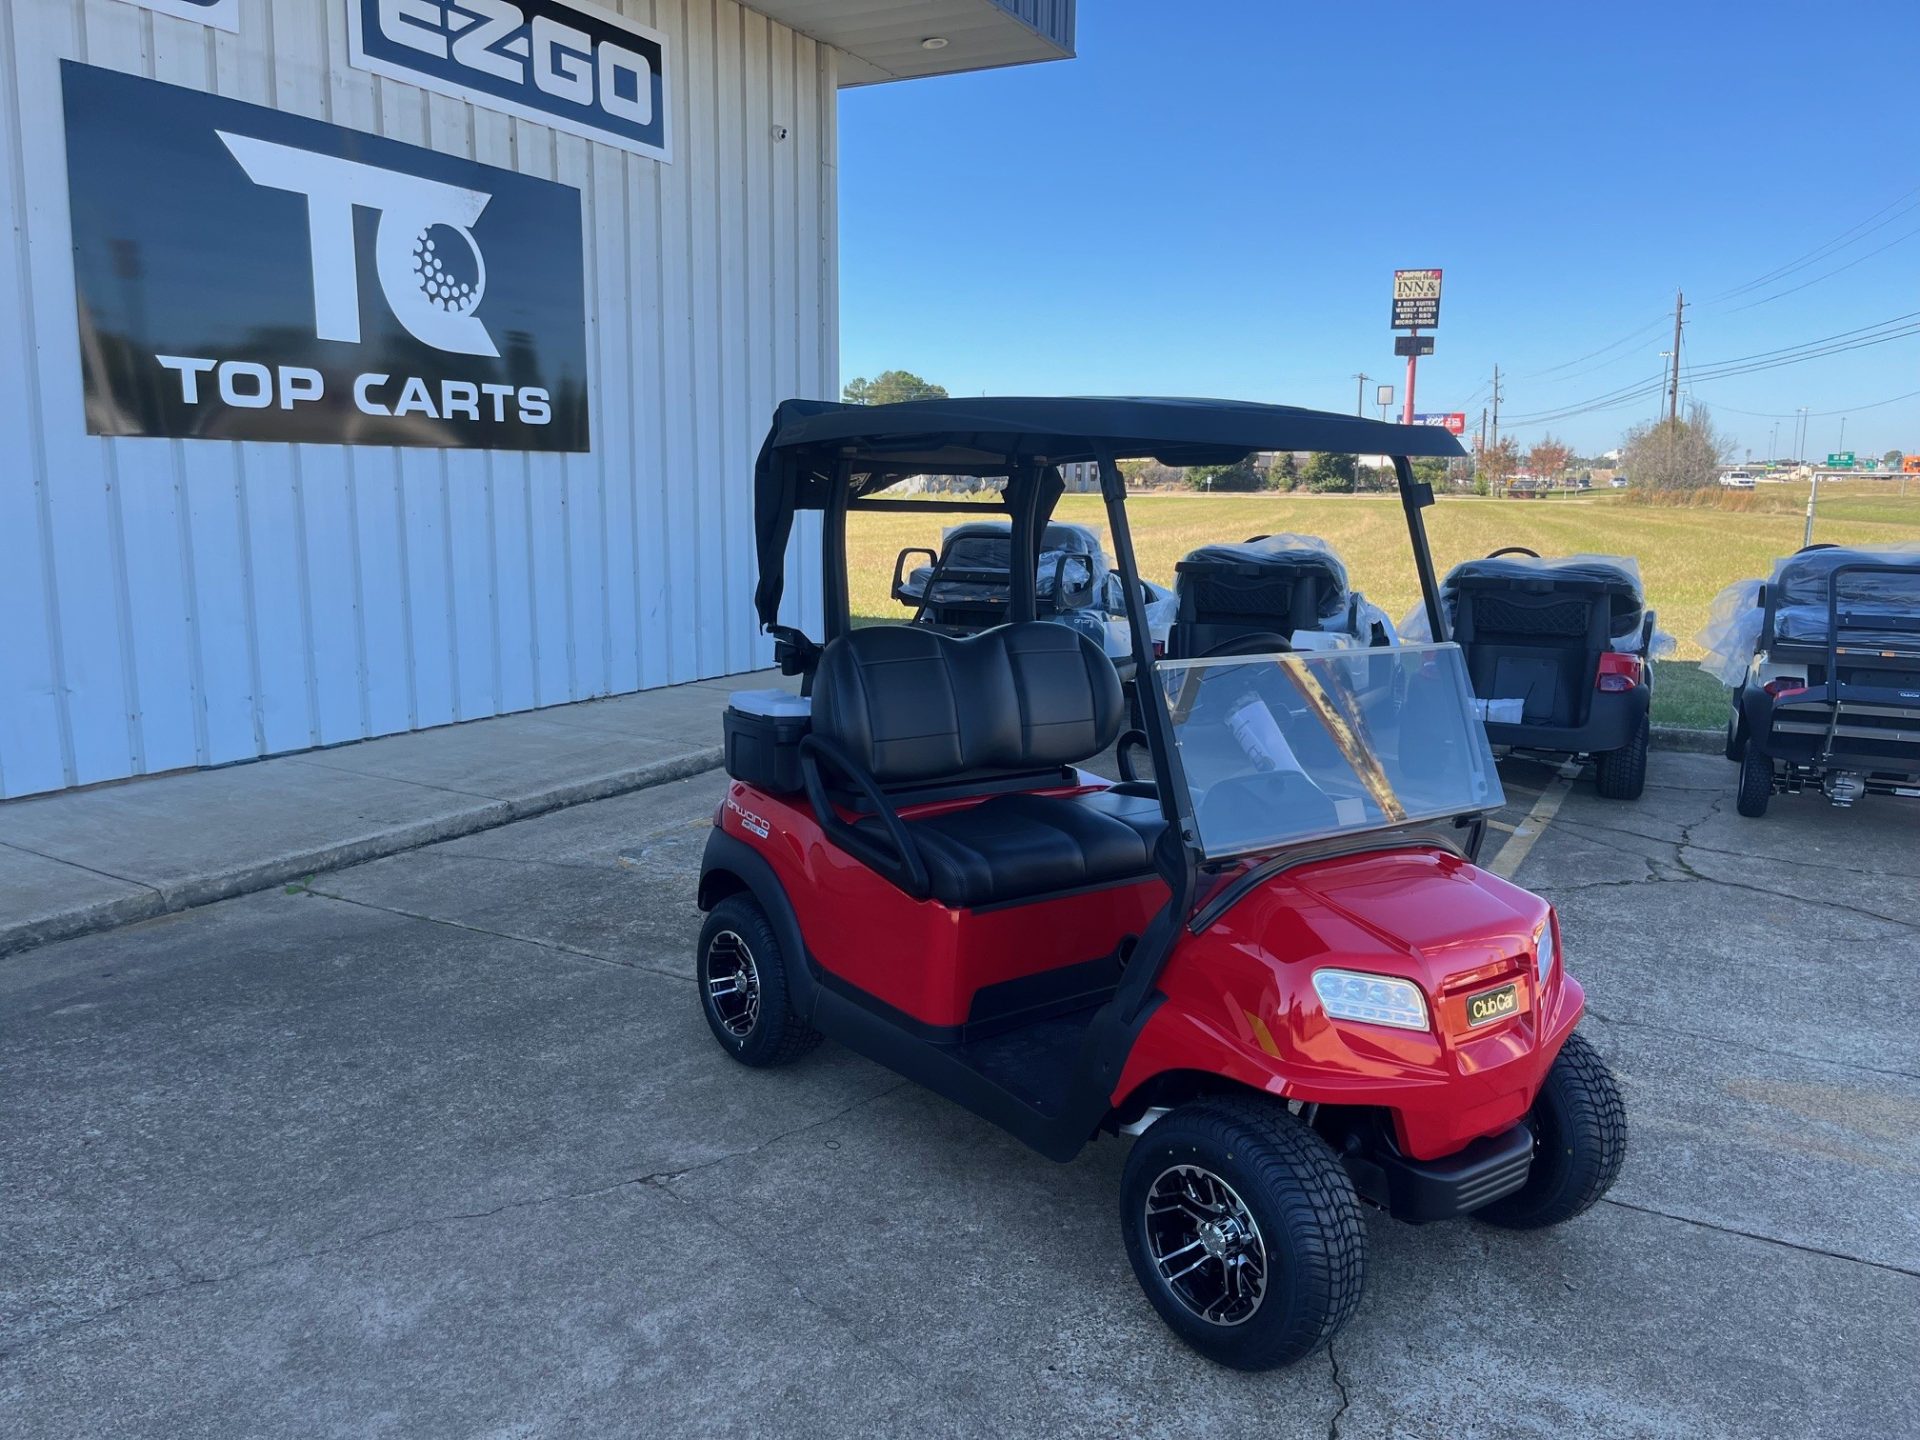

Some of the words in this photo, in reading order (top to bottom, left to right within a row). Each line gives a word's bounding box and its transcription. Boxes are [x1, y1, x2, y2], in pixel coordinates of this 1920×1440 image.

[1398, 281, 1425, 292] INN
[1427, 281, 1436, 292] &
[155, 354, 325, 410] TOP
[354, 373, 552, 425] CARTS
[1473, 998, 1496, 1017] Club
[1497, 994, 1513, 1010] Car
